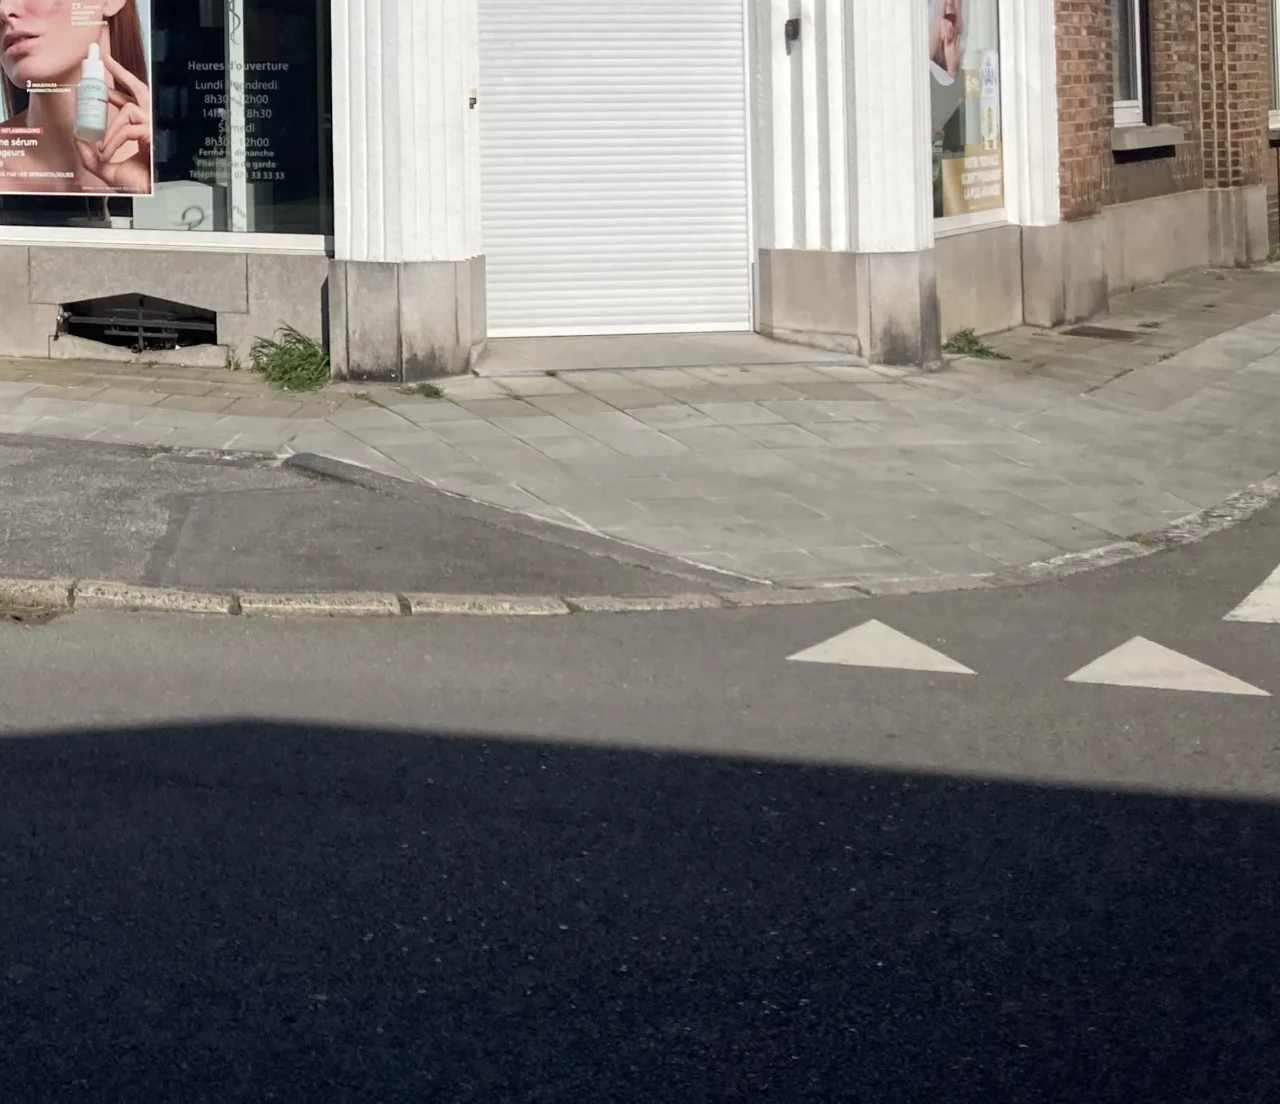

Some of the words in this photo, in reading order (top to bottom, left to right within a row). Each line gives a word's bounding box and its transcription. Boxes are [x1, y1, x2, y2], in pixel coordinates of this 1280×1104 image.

[187, 60, 225, 71] Heures
[229, 60, 289, 71] d'ouverture
[26, 80, 32, 88] 3
[195, 80, 223, 90] Lundi
[204, 94, 229, 104] 8h30
[241, 108, 272, 118] 8h30
[218, 122, 255, 133] Samedi
[11, 137, 38, 147] sérum
[204, 137, 230, 147] 8h30
[239, 137, 269, 147] 12h00
[252, 159, 277, 170] garde
[251, 171, 261, 180] 33
[263, 171, 273, 180] 33
[275, 171, 285, 180] 33
